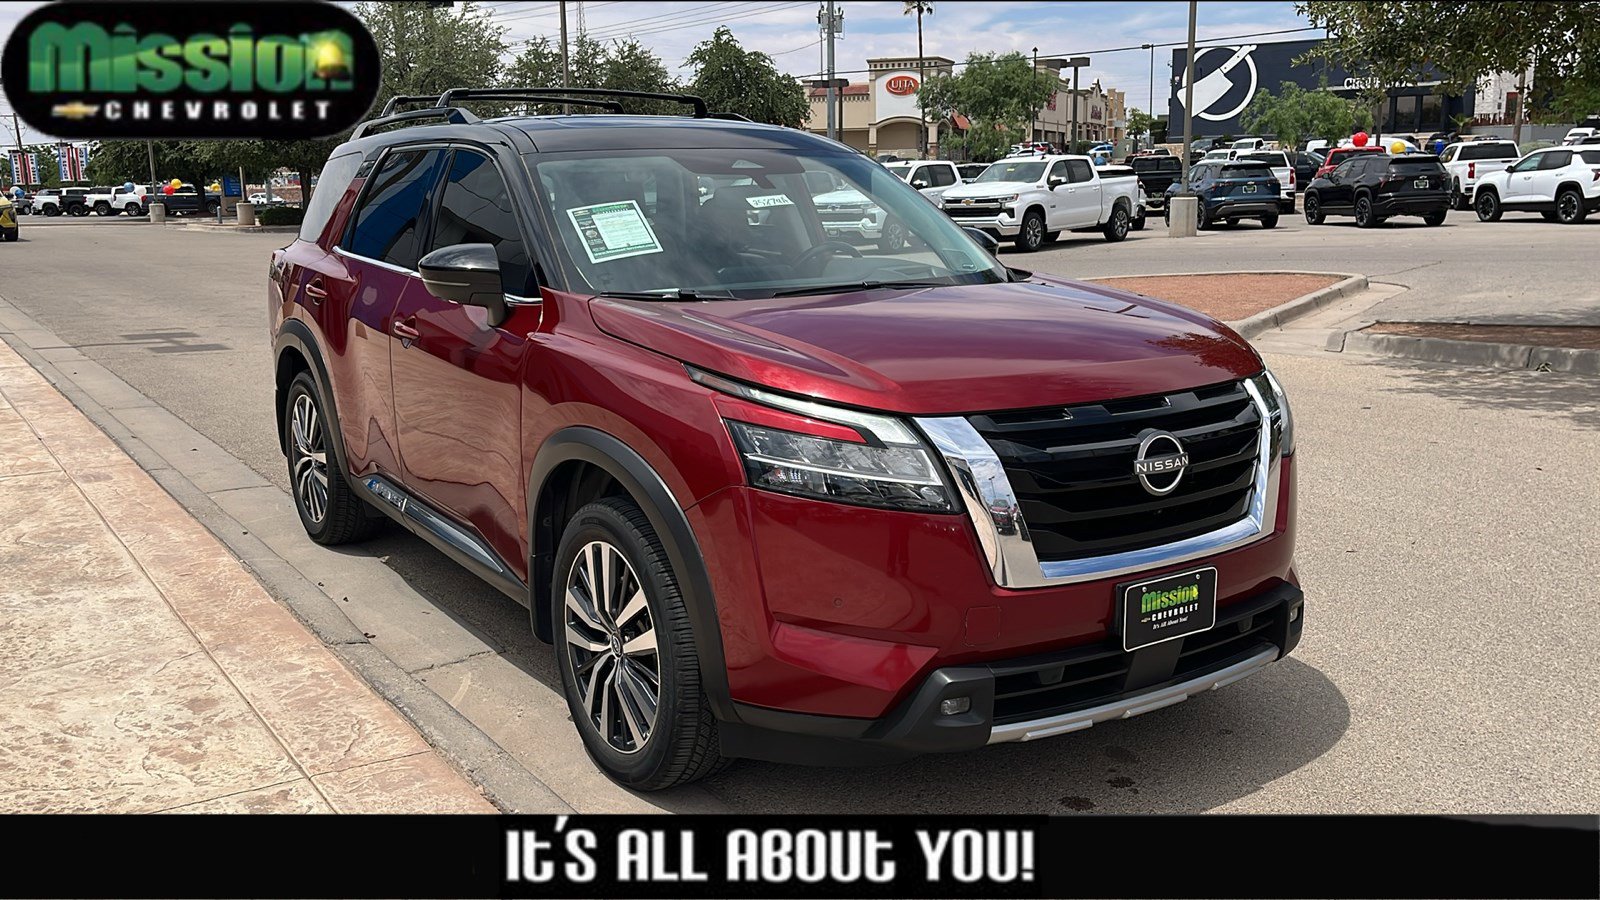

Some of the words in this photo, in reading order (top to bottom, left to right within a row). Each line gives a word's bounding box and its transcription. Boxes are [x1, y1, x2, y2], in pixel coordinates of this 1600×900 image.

[1136, 455, 1189, 473] NISSAN
[1141, 584, 1199, 614] Mission
[1151, 603, 1199, 622] CHEVROLET
